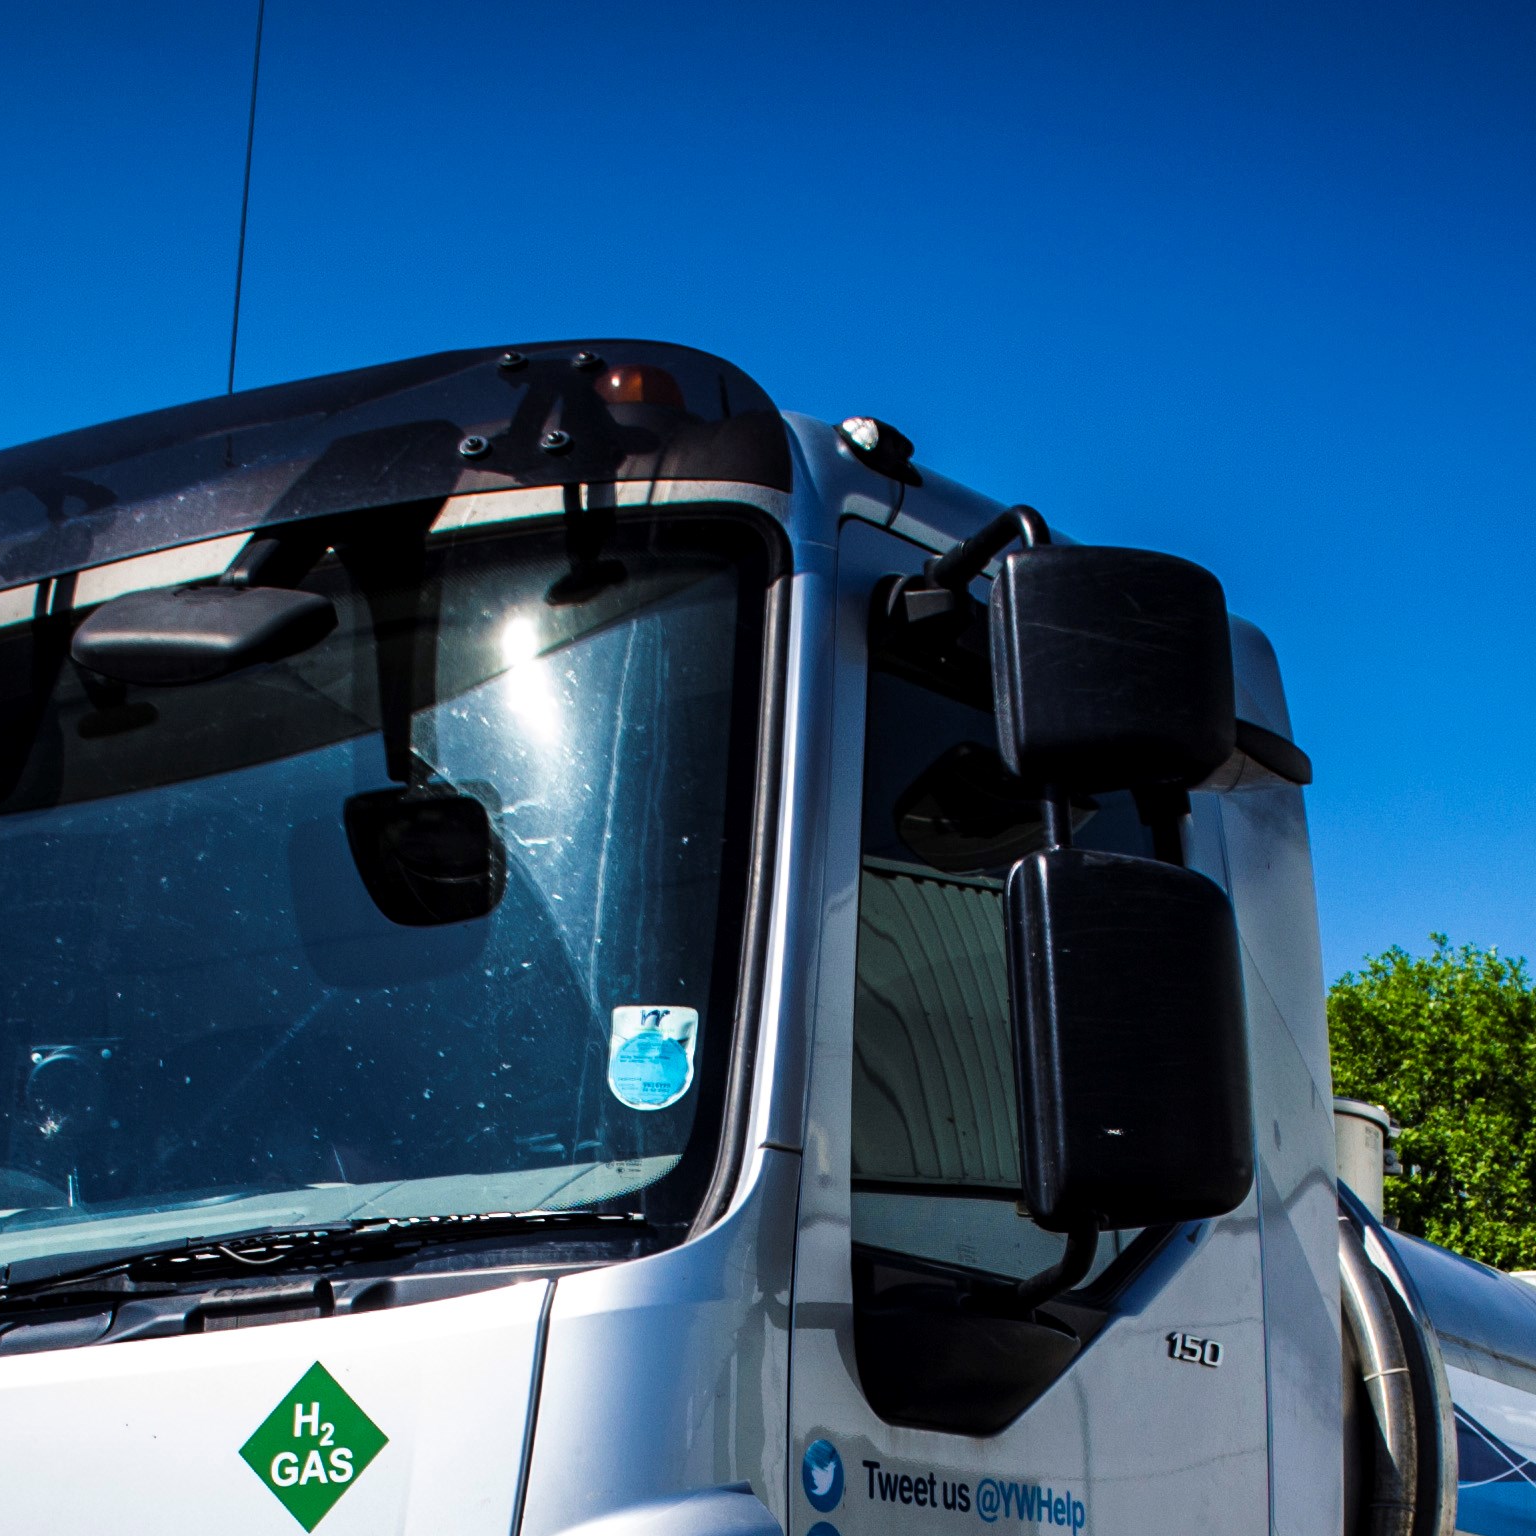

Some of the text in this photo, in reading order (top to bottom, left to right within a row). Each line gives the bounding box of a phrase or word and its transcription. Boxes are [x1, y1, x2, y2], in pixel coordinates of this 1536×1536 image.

[1166, 1332, 1224, 1367] 150
[271, 1447, 354, 1487] GAS
[862, 1460, 1086, 1536] Tweet us @YWHelp
